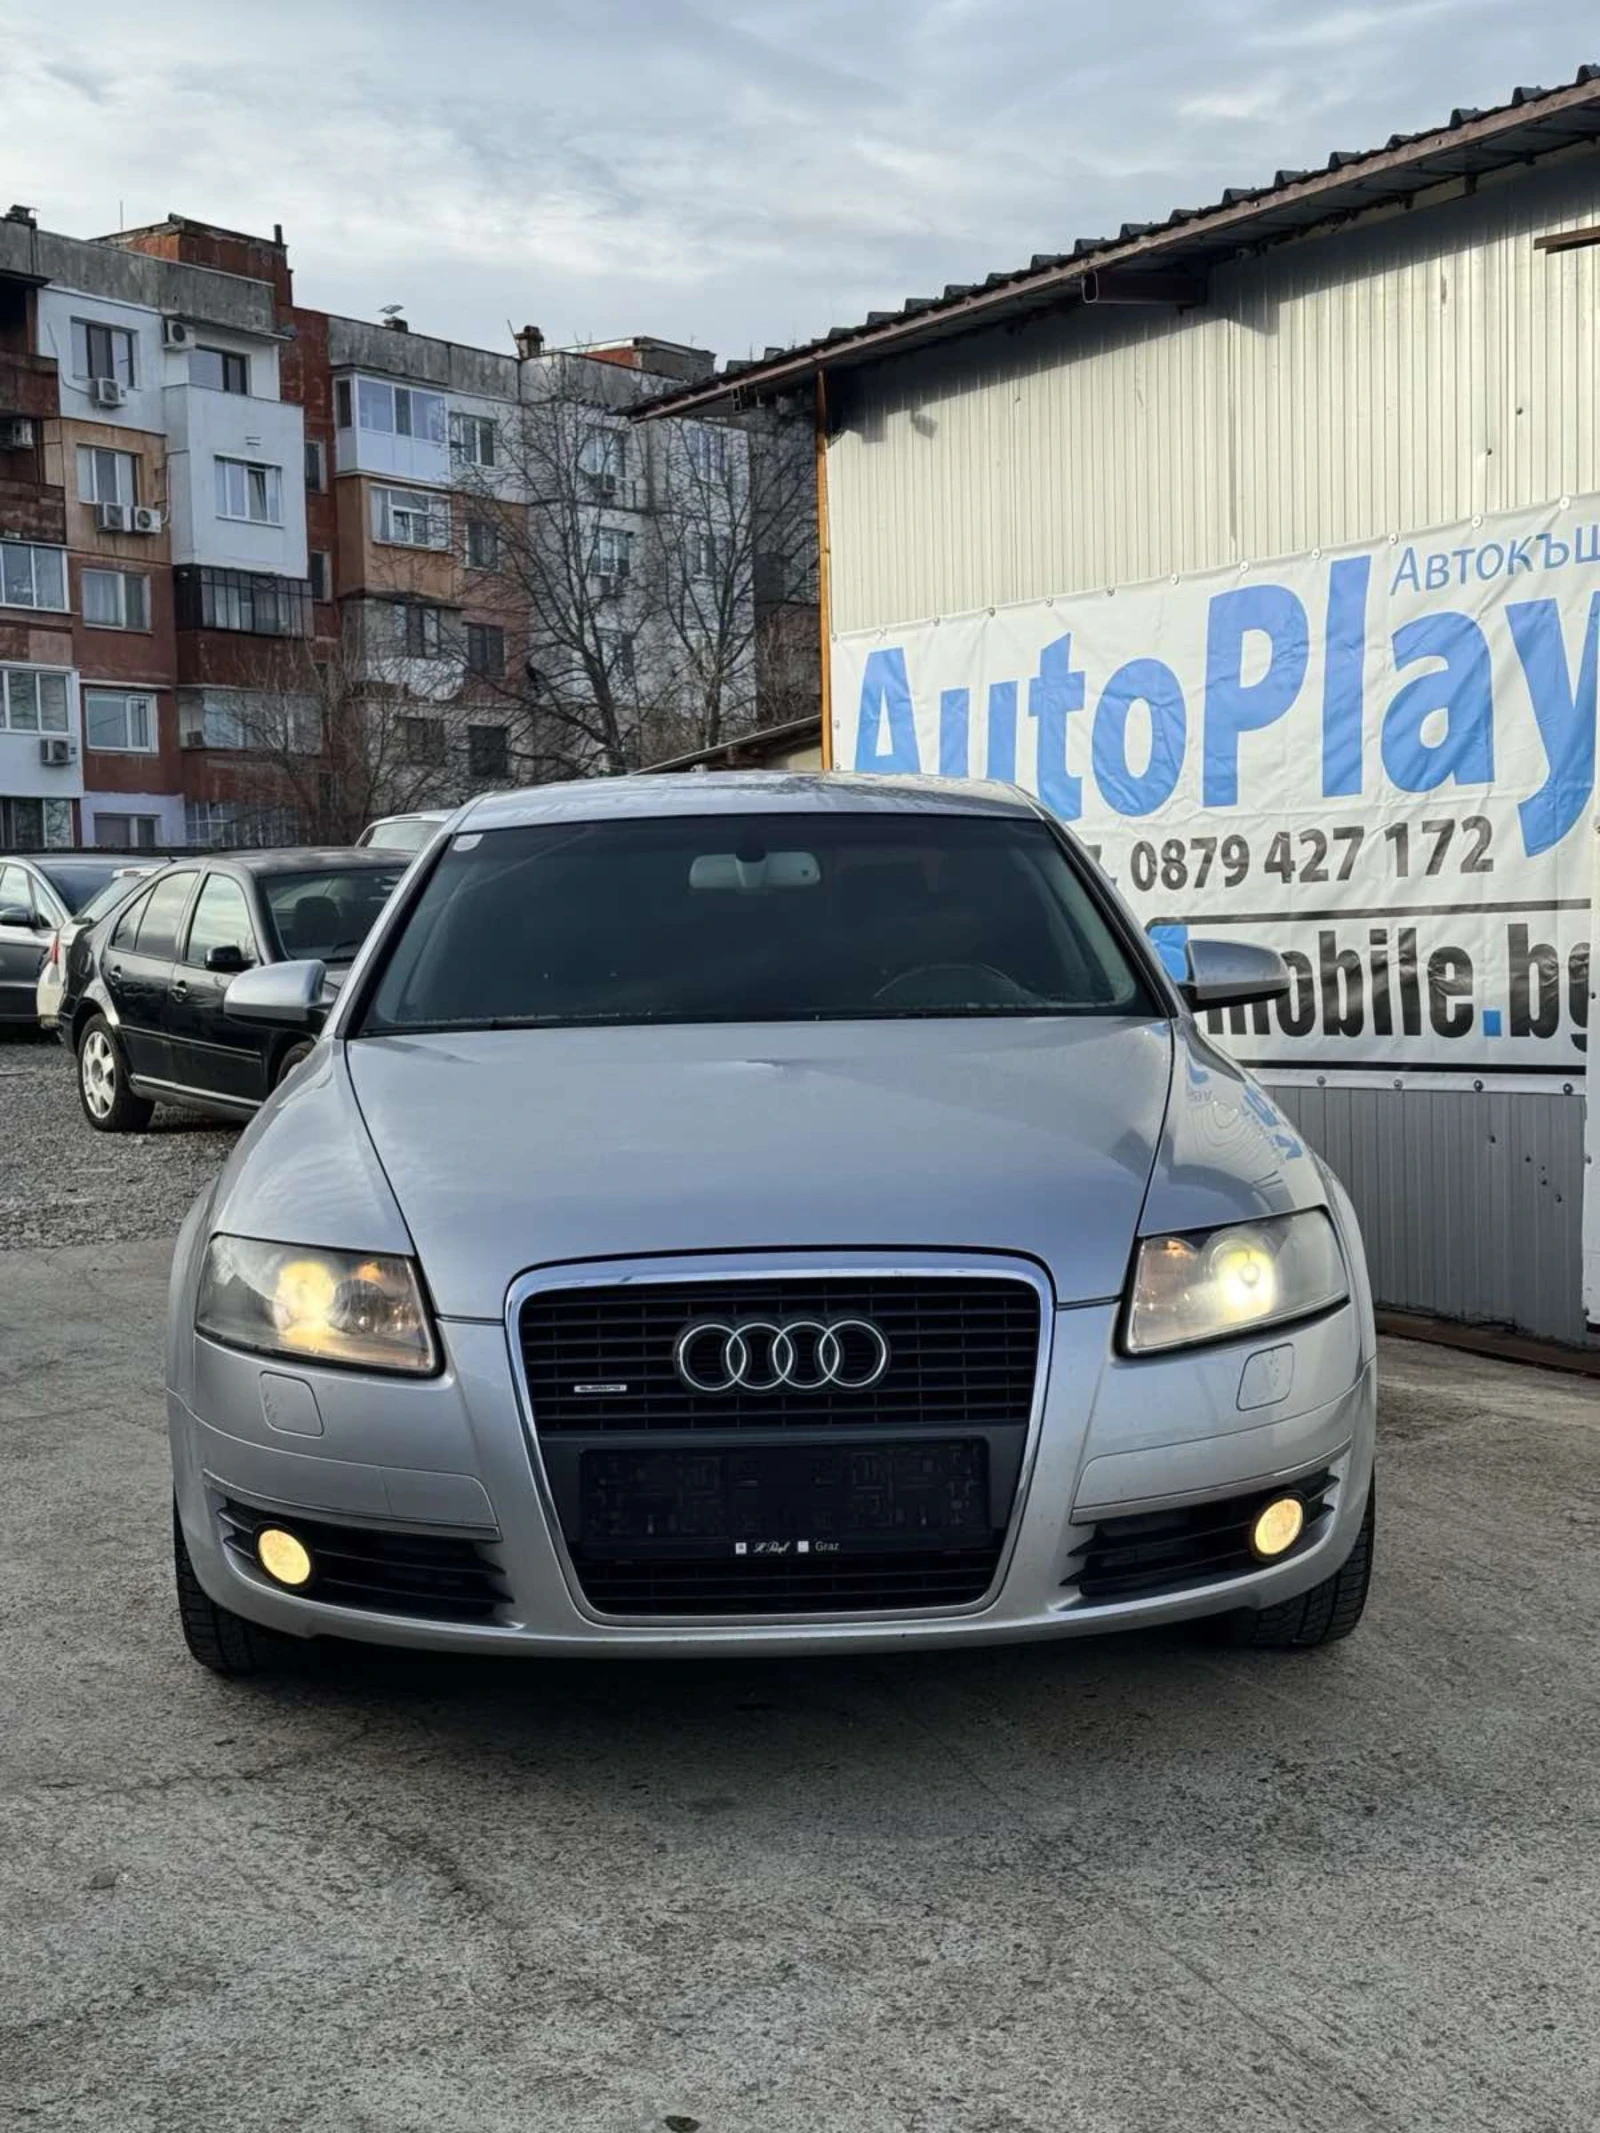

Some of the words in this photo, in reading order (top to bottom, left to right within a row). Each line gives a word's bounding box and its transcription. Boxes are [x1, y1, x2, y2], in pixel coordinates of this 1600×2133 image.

[854, 554, 1600, 858] AutoPlay
[1130, 834, 1250, 892] 0879
[1264, 828, 1365, 884] 427
[1384, 815, 1494, 879] 172
